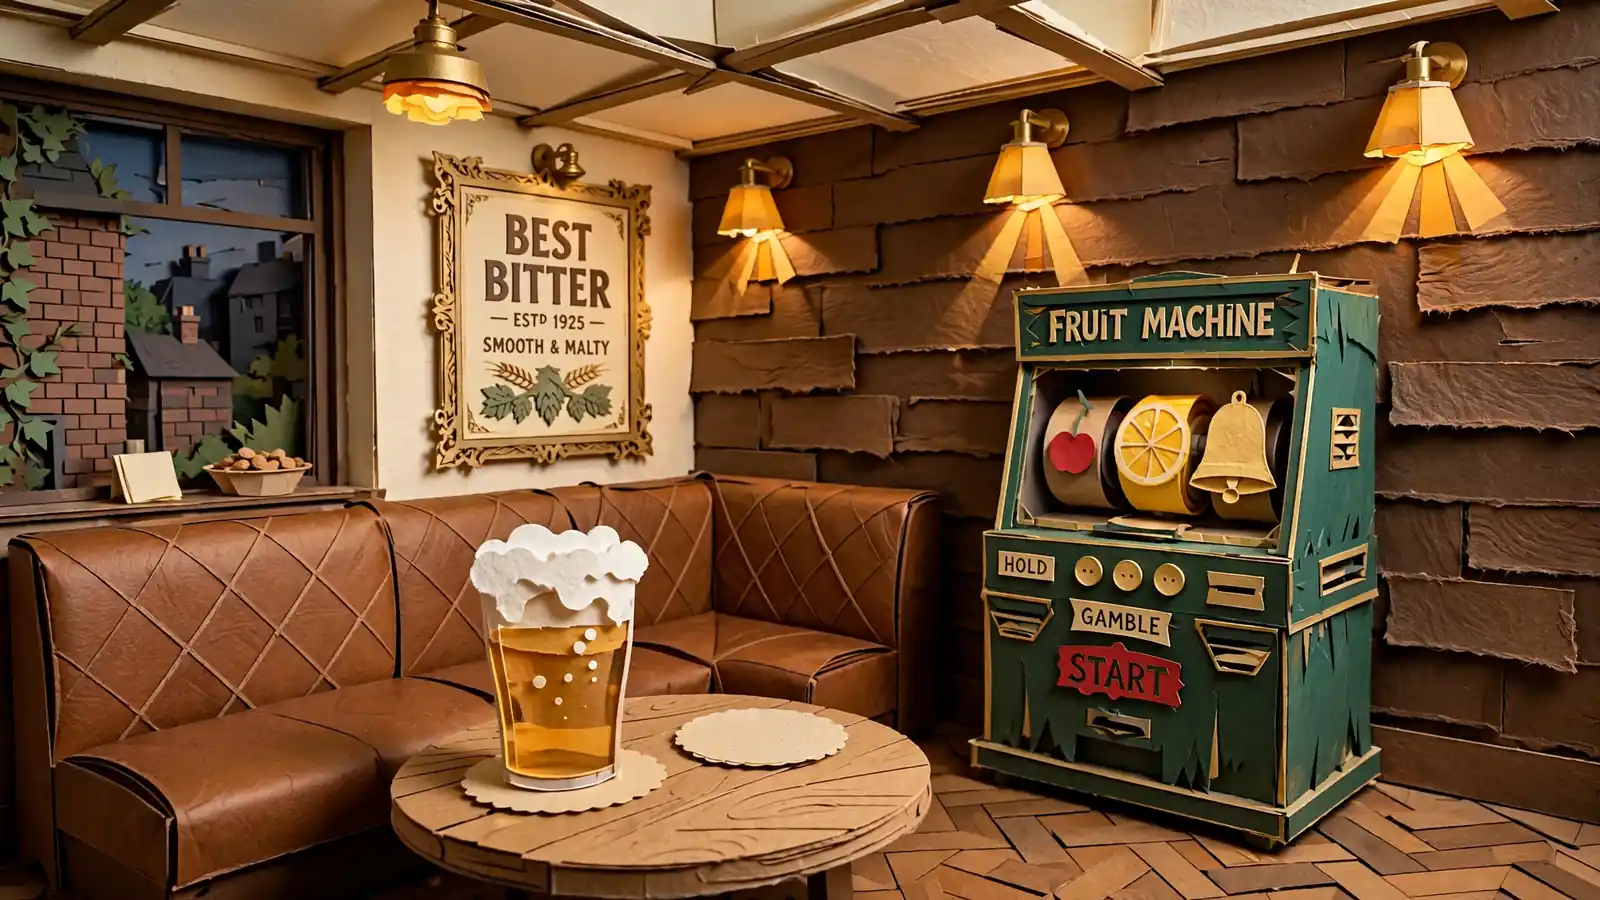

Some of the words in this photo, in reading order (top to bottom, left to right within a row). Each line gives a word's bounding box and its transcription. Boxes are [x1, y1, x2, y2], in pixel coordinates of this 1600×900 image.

[505, 213, 592, 261] BEST
[484, 259, 612, 309] BITTER
[513, 313, 547, 328] ESTD
[553, 315, 585, 330] 1925
[483, 337, 544, 355] SMOOTH
[550, 340, 560, 354] &
[565, 340, 610, 356] MALTY
[1004, 556, 1048, 576] HOLD
[1081, 607, 1161, 636] GAMBLE
[1069, 653, 1169, 698] START
